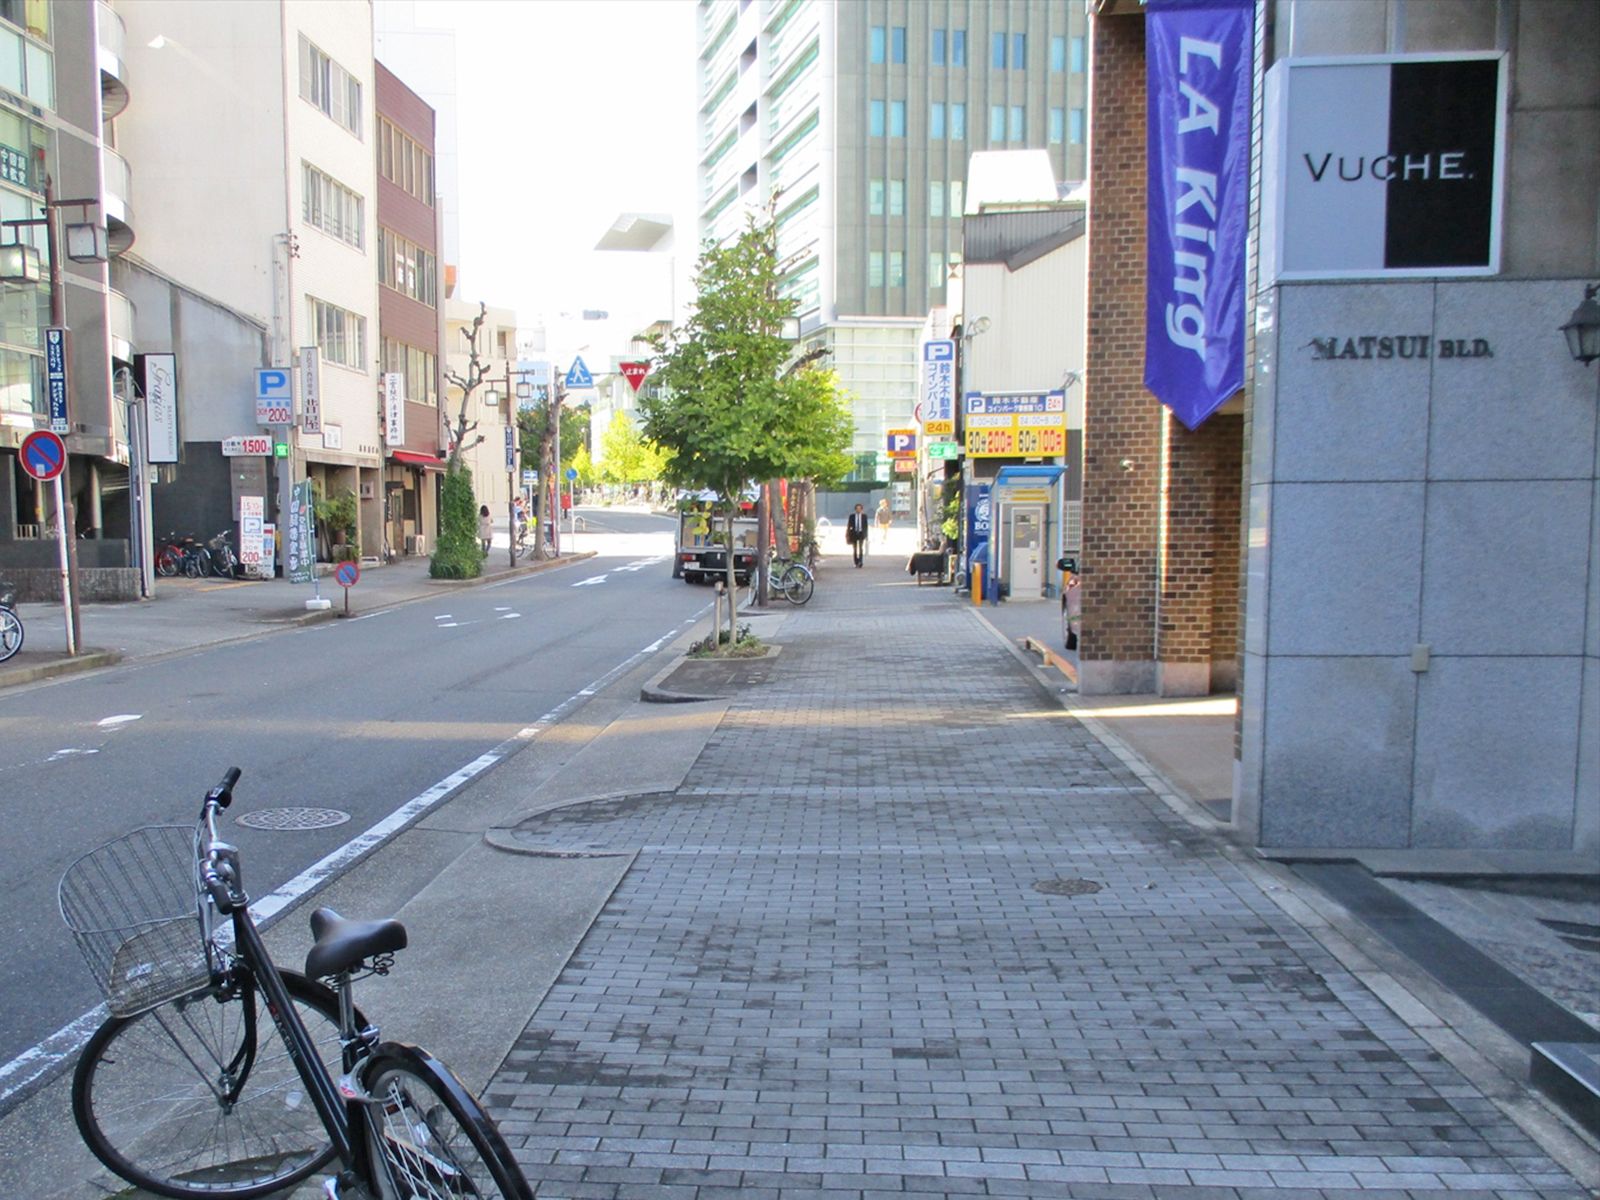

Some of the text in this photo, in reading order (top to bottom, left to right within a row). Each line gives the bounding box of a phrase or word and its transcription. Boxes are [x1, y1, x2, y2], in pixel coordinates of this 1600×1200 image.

[1165, 167, 1217, 363] King
[1438, 338, 1495, 359] BLD.
[625, 367, 646, 376] 止まれ
[260, 371, 287, 396] P
[927, 362, 938, 420] コインパーク
[939, 362, 951, 420] 鈴木不動産
[927, 423, 950, 434] 24h
[895, 434, 911, 452] P
